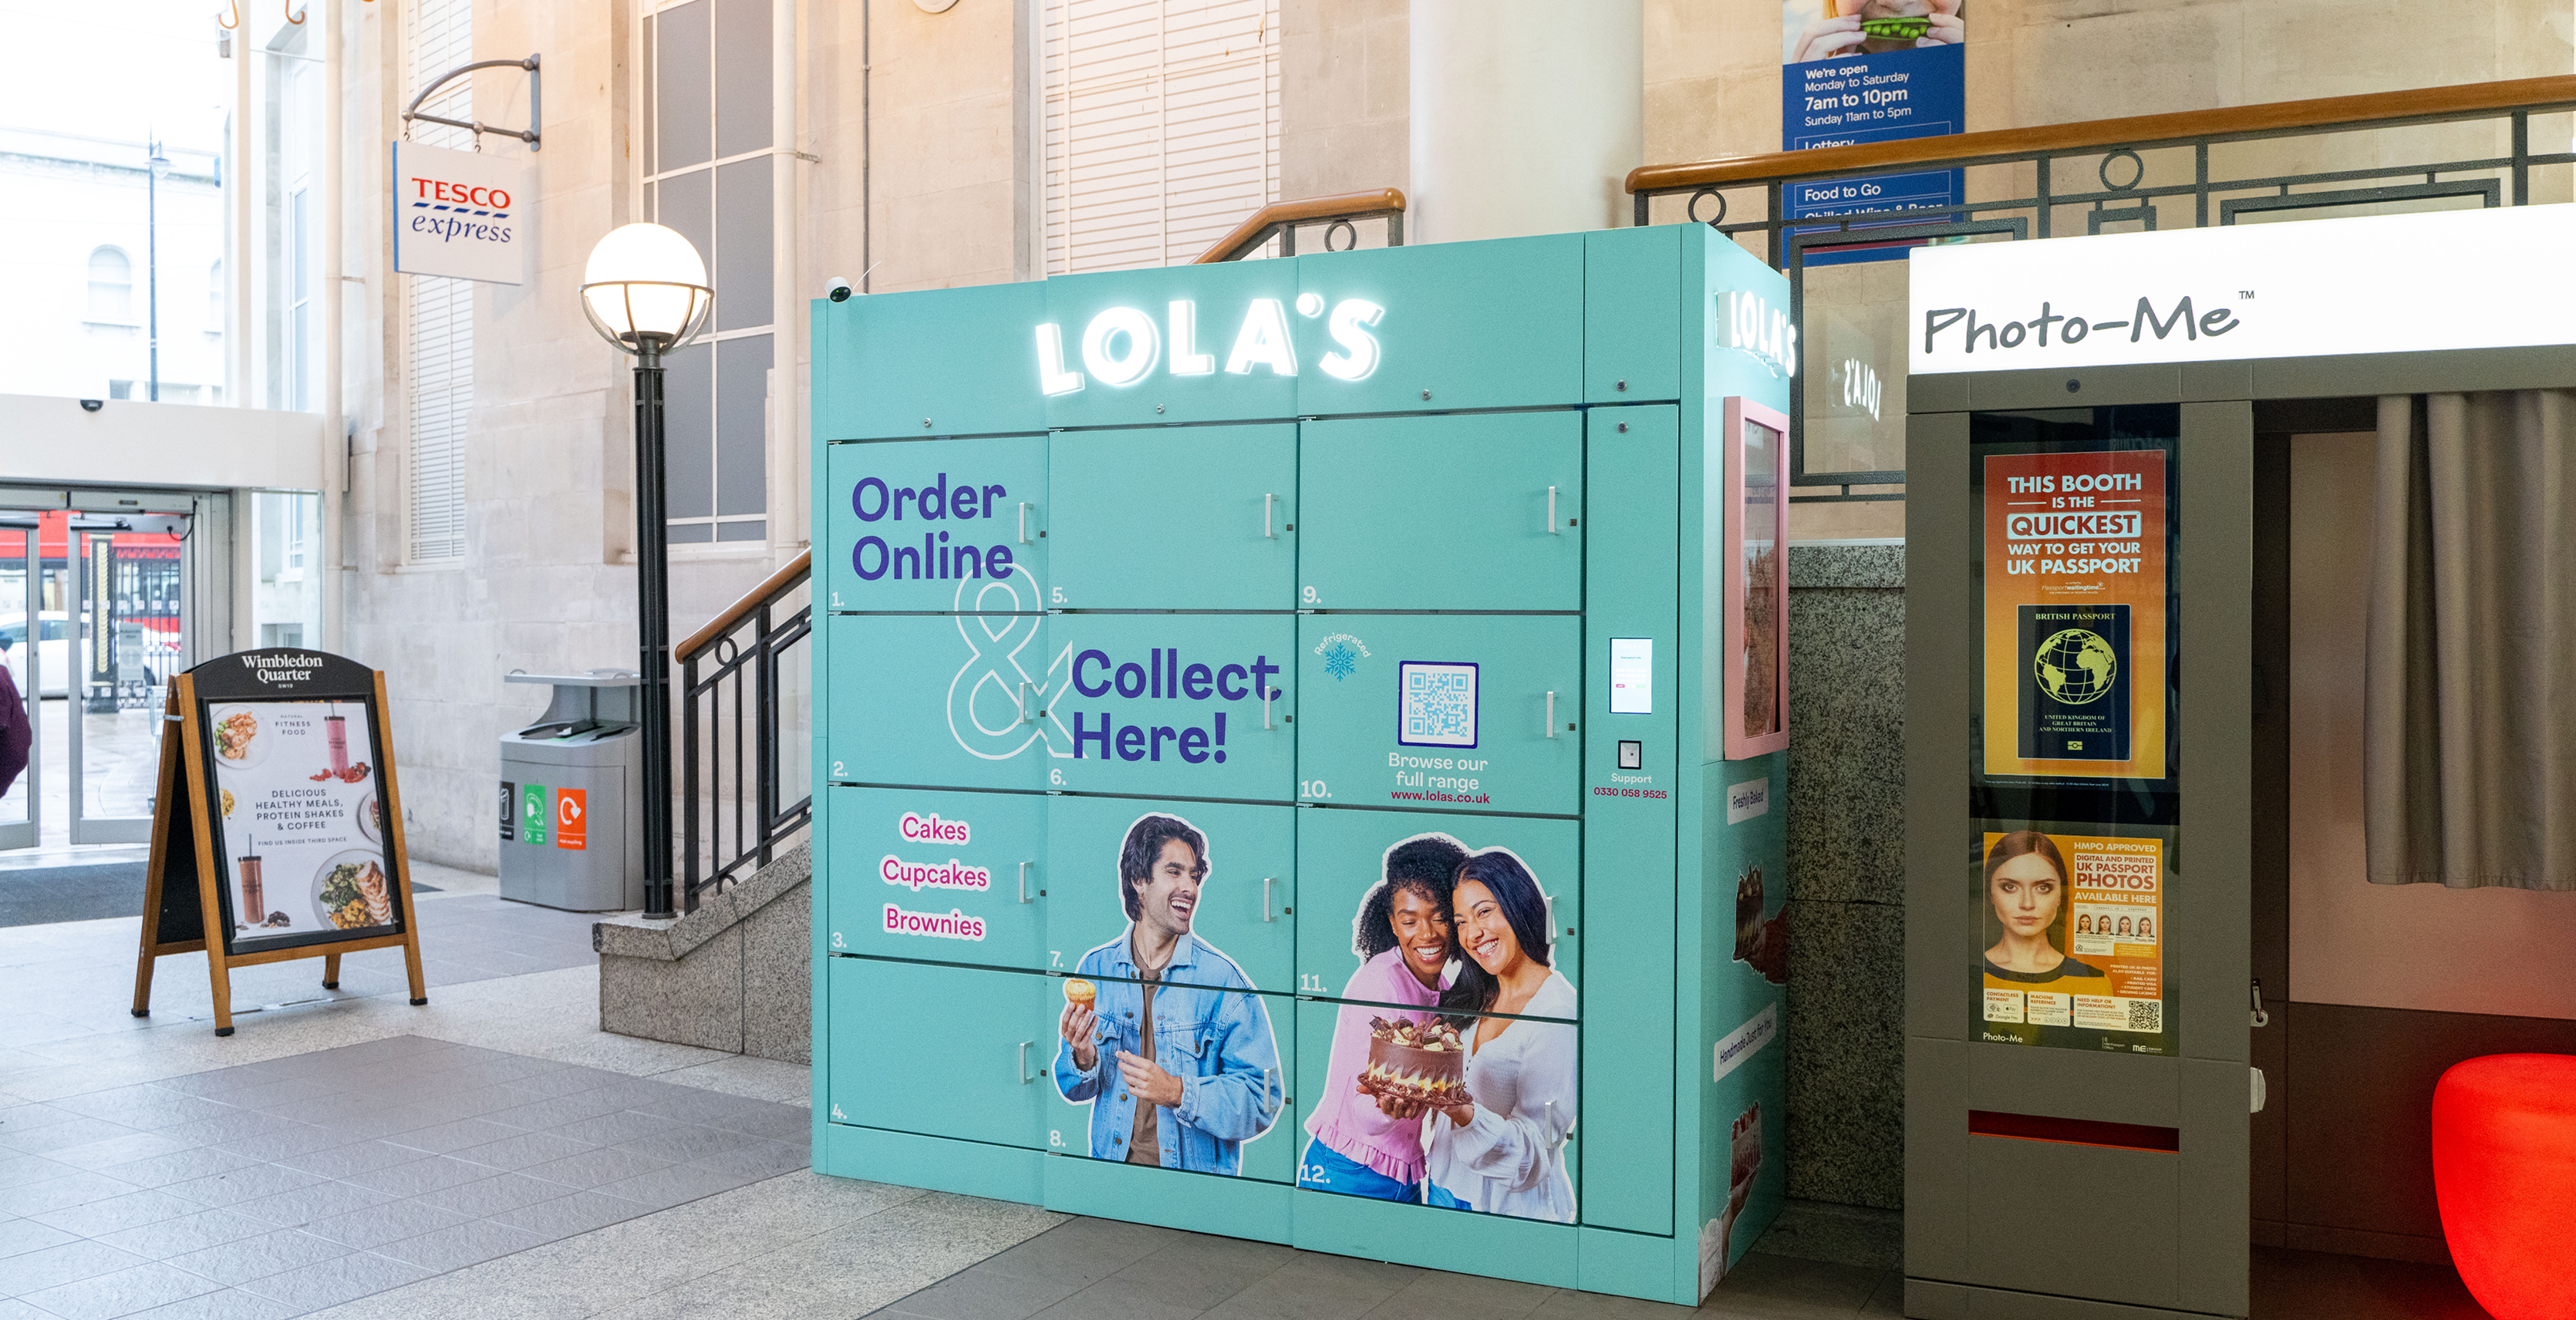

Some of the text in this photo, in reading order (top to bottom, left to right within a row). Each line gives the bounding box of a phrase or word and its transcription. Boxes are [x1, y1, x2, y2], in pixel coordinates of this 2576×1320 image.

[1839, 65, 1868, 76] open
[1805, 72, 1910, 92] Monday to Saturday
[1805, 89, 1908, 111] 7am to 10pm
[1805, 107, 1912, 126] Sunday 11am to 5pm
[412, 177, 511, 209] TESCO
[1805, 184, 1881, 201] Food to Go
[412, 215, 511, 243] express
[1925, 296, 2240, 354] Photo-Me
[1035, 293, 1384, 396] LOLA'S
[2008, 473, 2141, 493] THIS BOOTH
[852, 472, 1006, 522] Order
[2052, 497, 2095, 509] IS THE
[2011, 514, 2137, 537] QUICKEST
[852, 530, 1013, 581] Online
[2008, 542, 2140, 555] WAY TO GET YOUR
[2007, 558, 2141, 574] UK PASSPORT
[831, 591, 845, 607] 1.
[1051, 587, 1068, 604] 5.
[1303, 586, 1322, 604] 9.
[1314, 632, 1371, 658] Refrigerated
[241, 655, 323, 668] Wimbledon
[257, 668, 312, 684] Quarter
[1072, 648, 1282, 702] Collect
[1074, 712, 1227, 764] Here!
[833, 761, 848, 777] 2.
[1388, 753, 1489, 771] Browse our
[1050, 769, 1067, 786] 6.
[1396, 772, 1479, 793] full range
[1611, 773, 1652, 785] Support
[271, 789, 326, 798] DELICIOUS
[1301, 780, 1332, 798] 10.
[1391, 790, 1490, 804] www.lolas.co.uk
[1594, 787, 1667, 799] 0330 058 9525
[256, 799, 344, 810] HEALTHY MEALS,
[1732, 788, 1764, 810] Freshly Baked
[257, 810, 344, 820] PROTEIN SHAKES
[287, 821, 326, 830] COFFEE
[902, 816, 966, 841] Cakes
[2074, 842, 2156, 852] HMPO APPROVED
[882, 859, 987, 887] Cupcakes
[2076, 862, 2154, 874] UK PASSPORT
[2076, 873, 2154, 890] PHOTOS
[2075, 892, 2156, 904] AVAILABLE HERE
[886, 908, 983, 937] Brownies
[831, 931, 848, 948] 3.
[1050, 951, 1064, 968] 7.
[1300, 974, 1327, 992] 11.
[1983, 1032, 2023, 1042] Photo-Me
[1720, 1035, 1745, 1065] Handmade
[831, 1103, 848, 1120] 4.
[1049, 1129, 1067, 1147] 8.
[1300, 1164, 1331, 1184] 12.
